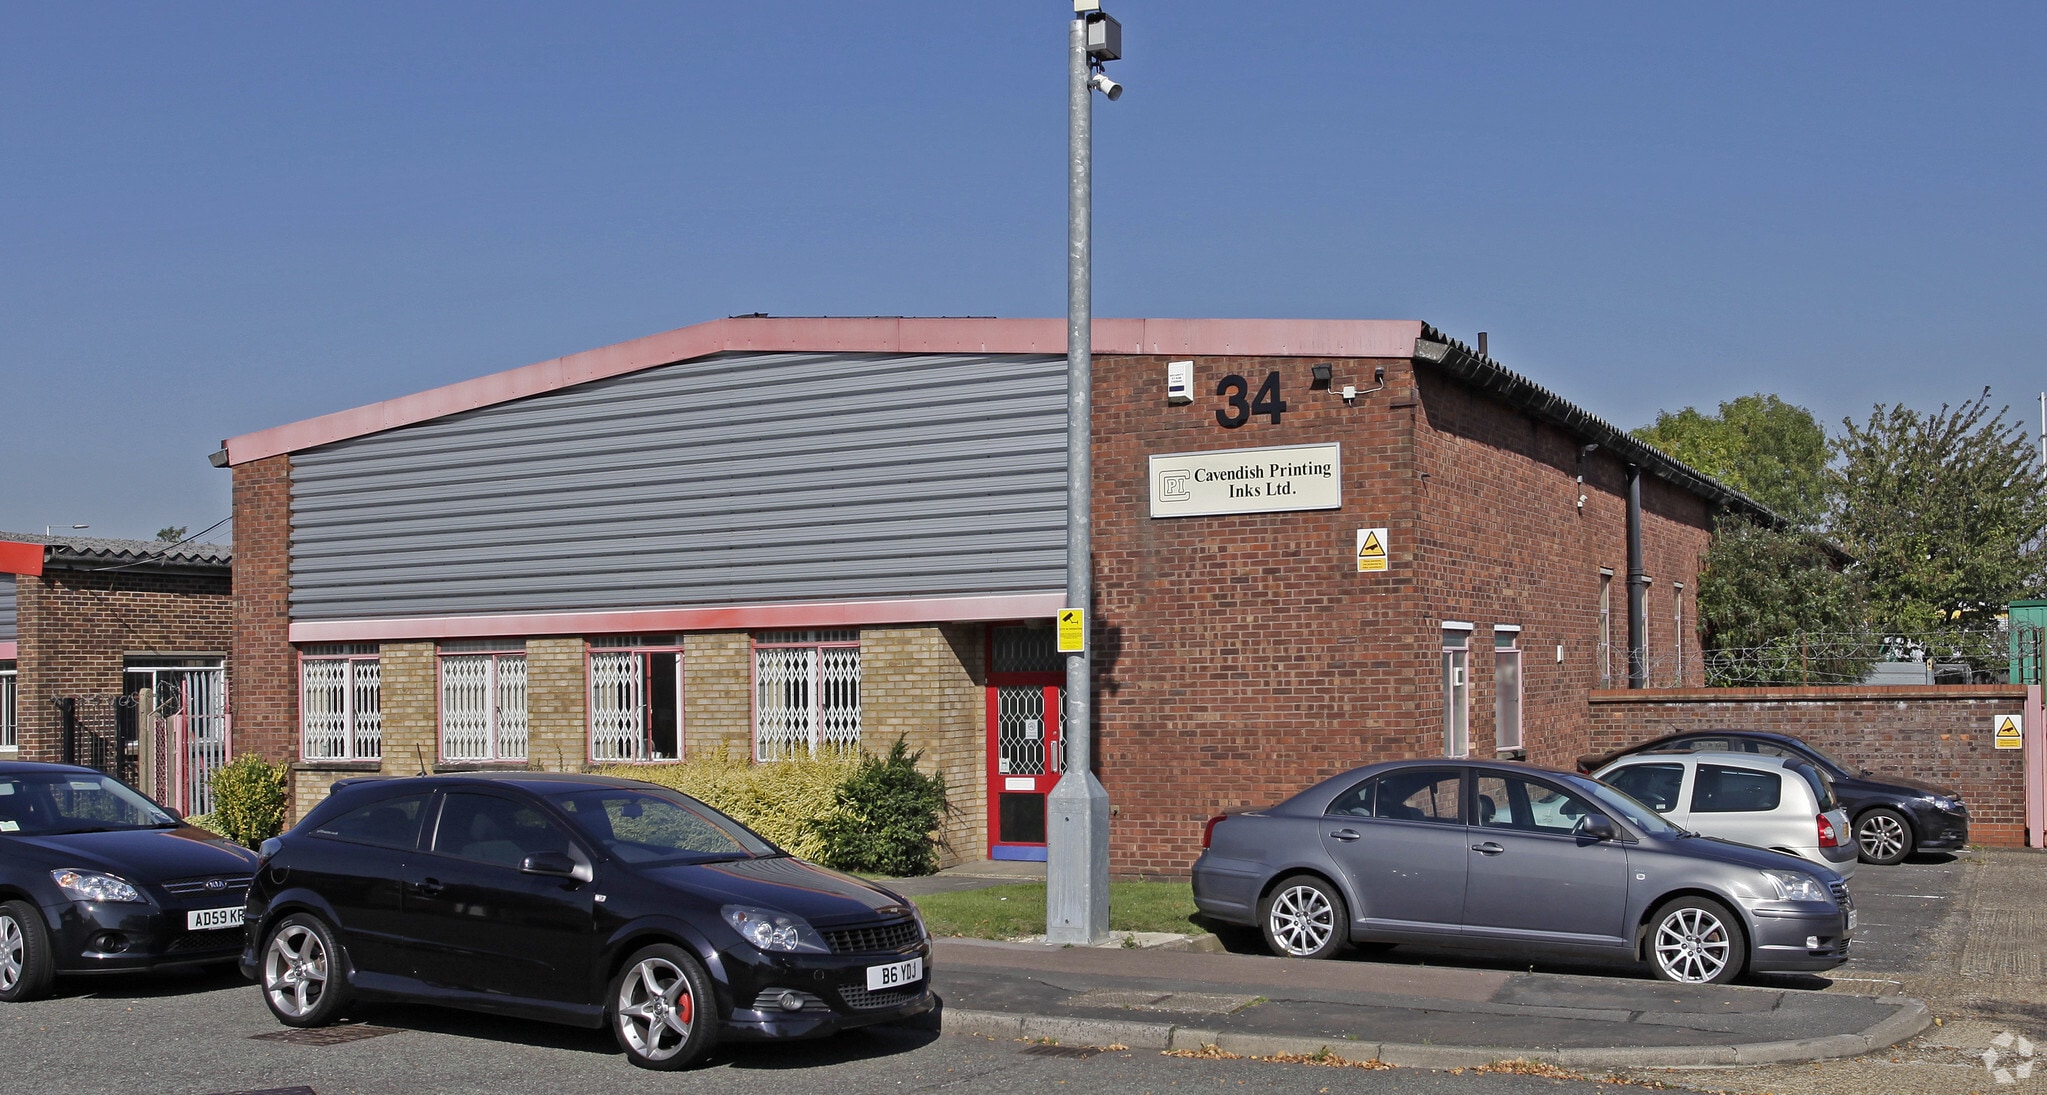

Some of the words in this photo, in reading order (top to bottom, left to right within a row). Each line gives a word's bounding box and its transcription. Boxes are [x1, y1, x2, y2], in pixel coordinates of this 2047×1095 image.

[1215, 371, 1287, 429] 34
[1194, 465, 1264, 483] Cavendish
[1269, 461, 1332, 479] Printing
[1229, 484, 1261, 498] Inks
[1266, 481, 1297, 497] Ltd.
[209, 880, 225, 888] KIA
[195, 911, 227, 927] AD59
[882, 966, 898, 985] B6
[901, 961, 917, 981] YDJ
